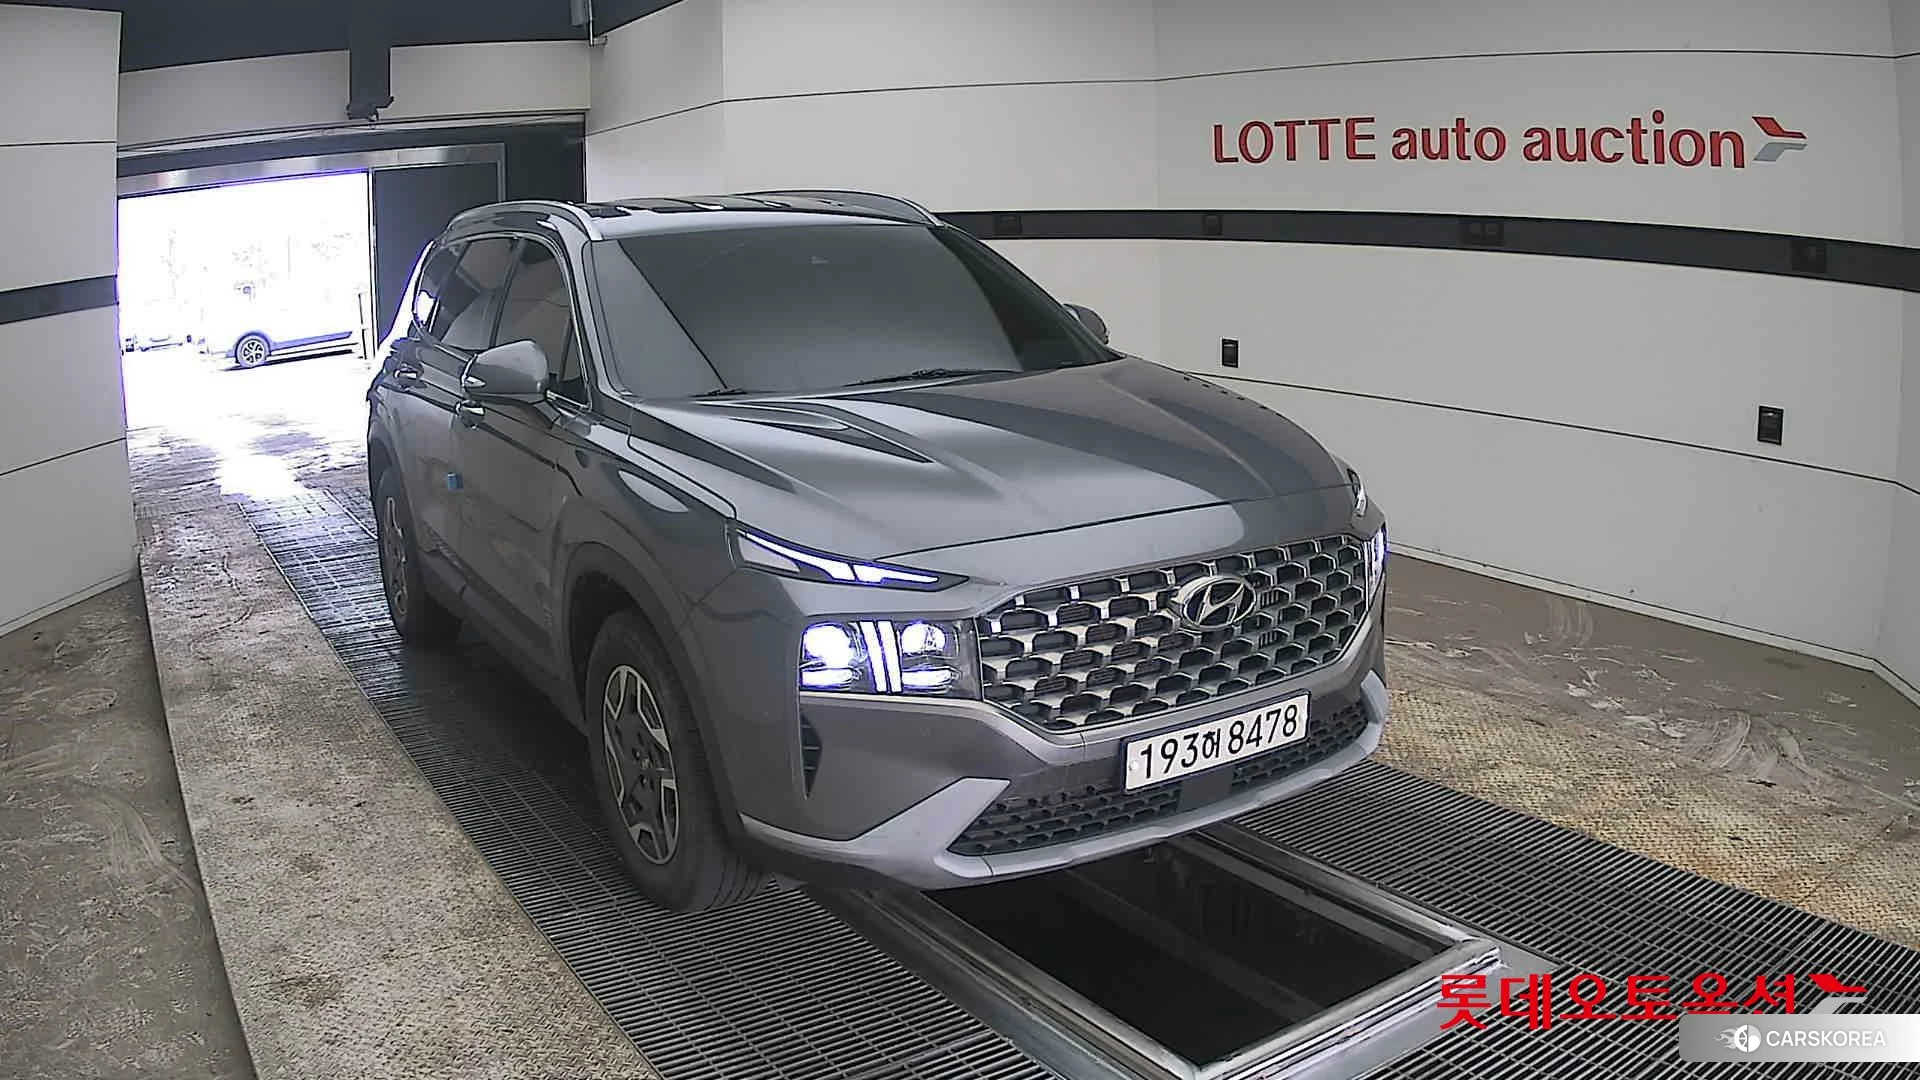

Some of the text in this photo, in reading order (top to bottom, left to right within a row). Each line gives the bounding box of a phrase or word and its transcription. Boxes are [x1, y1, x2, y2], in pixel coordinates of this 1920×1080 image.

[1213, 109, 1746, 169] LOTTE auto auction
[1227, 704, 1298, 755] 8478
